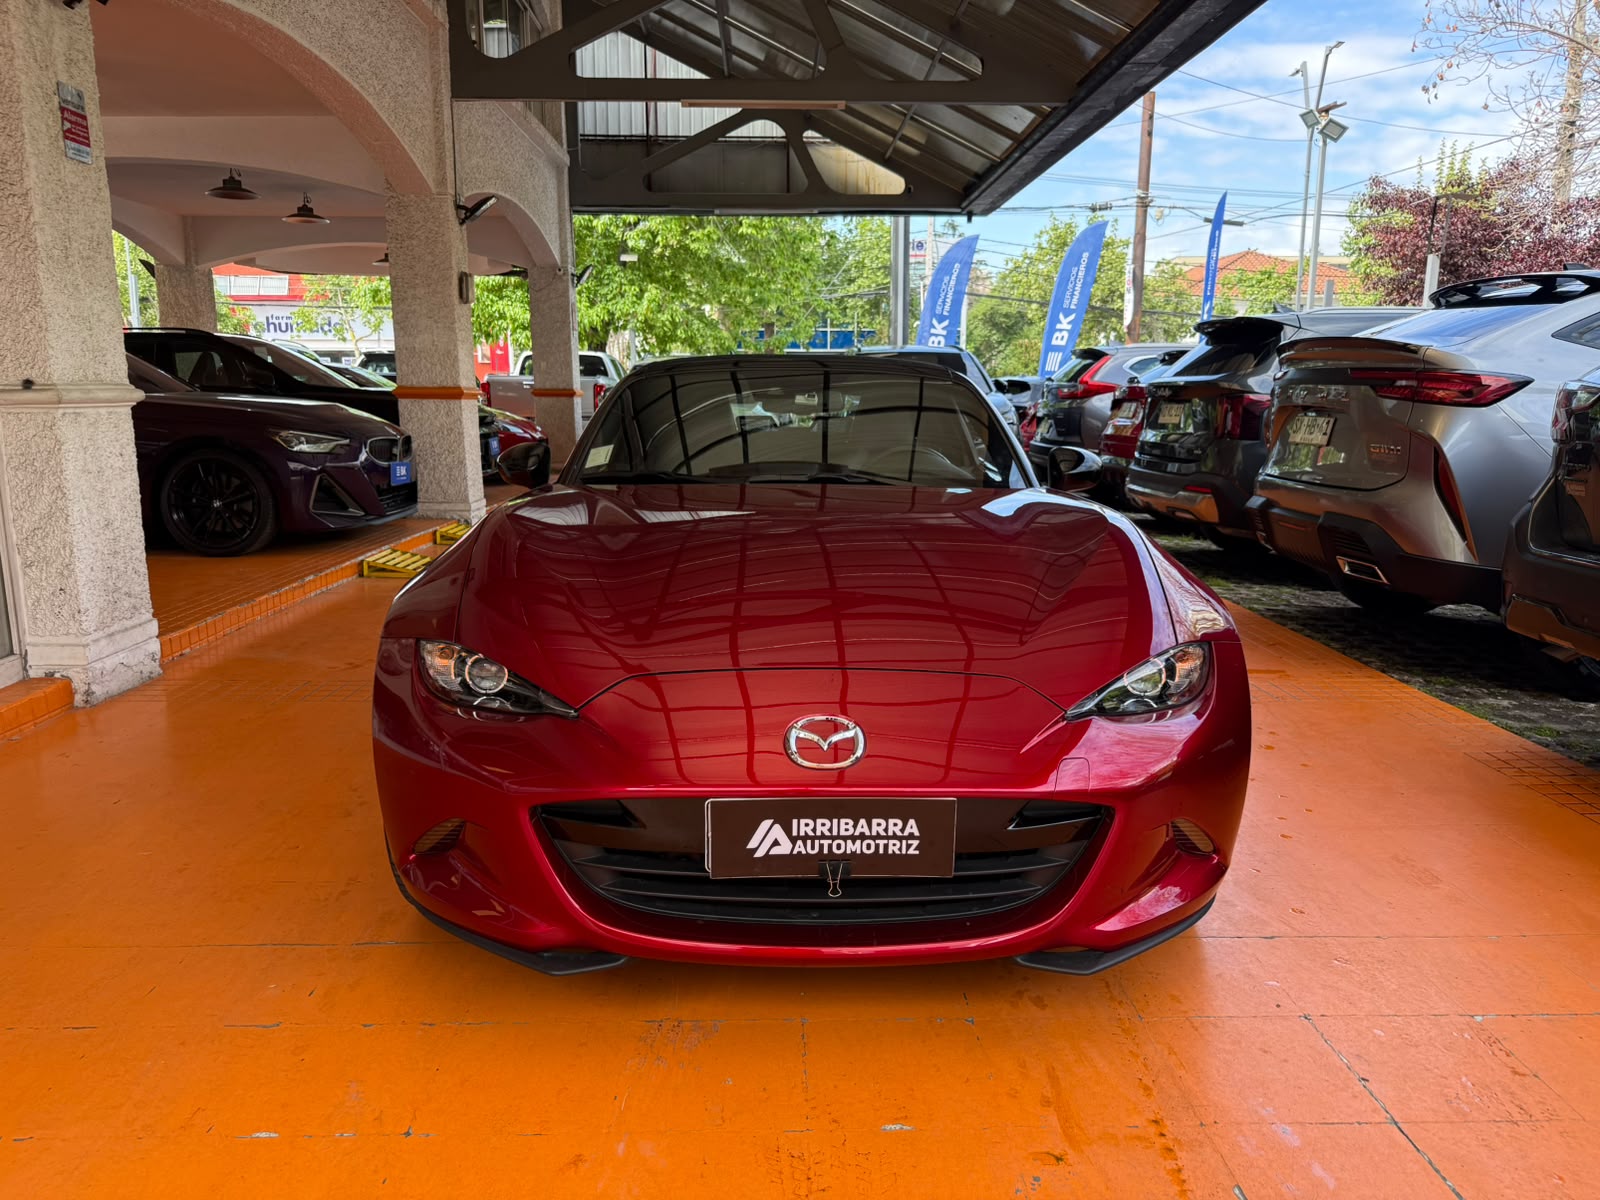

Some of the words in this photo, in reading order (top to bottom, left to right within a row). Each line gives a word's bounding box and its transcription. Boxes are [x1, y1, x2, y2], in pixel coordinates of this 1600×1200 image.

[935, 275, 950, 315] SERVICIOS
[943, 262, 961, 316] FINANCIEROS
[1063, 266, 1079, 309] SERVICIOS
[1070, 252, 1090, 310] FINANCIEROS
[928, 318, 950, 348] BK
[1051, 312, 1077, 347] BK
[792, 818, 921, 837] IRRIBARRA
[792, 839, 920, 855] AUTOMOTRIZ
